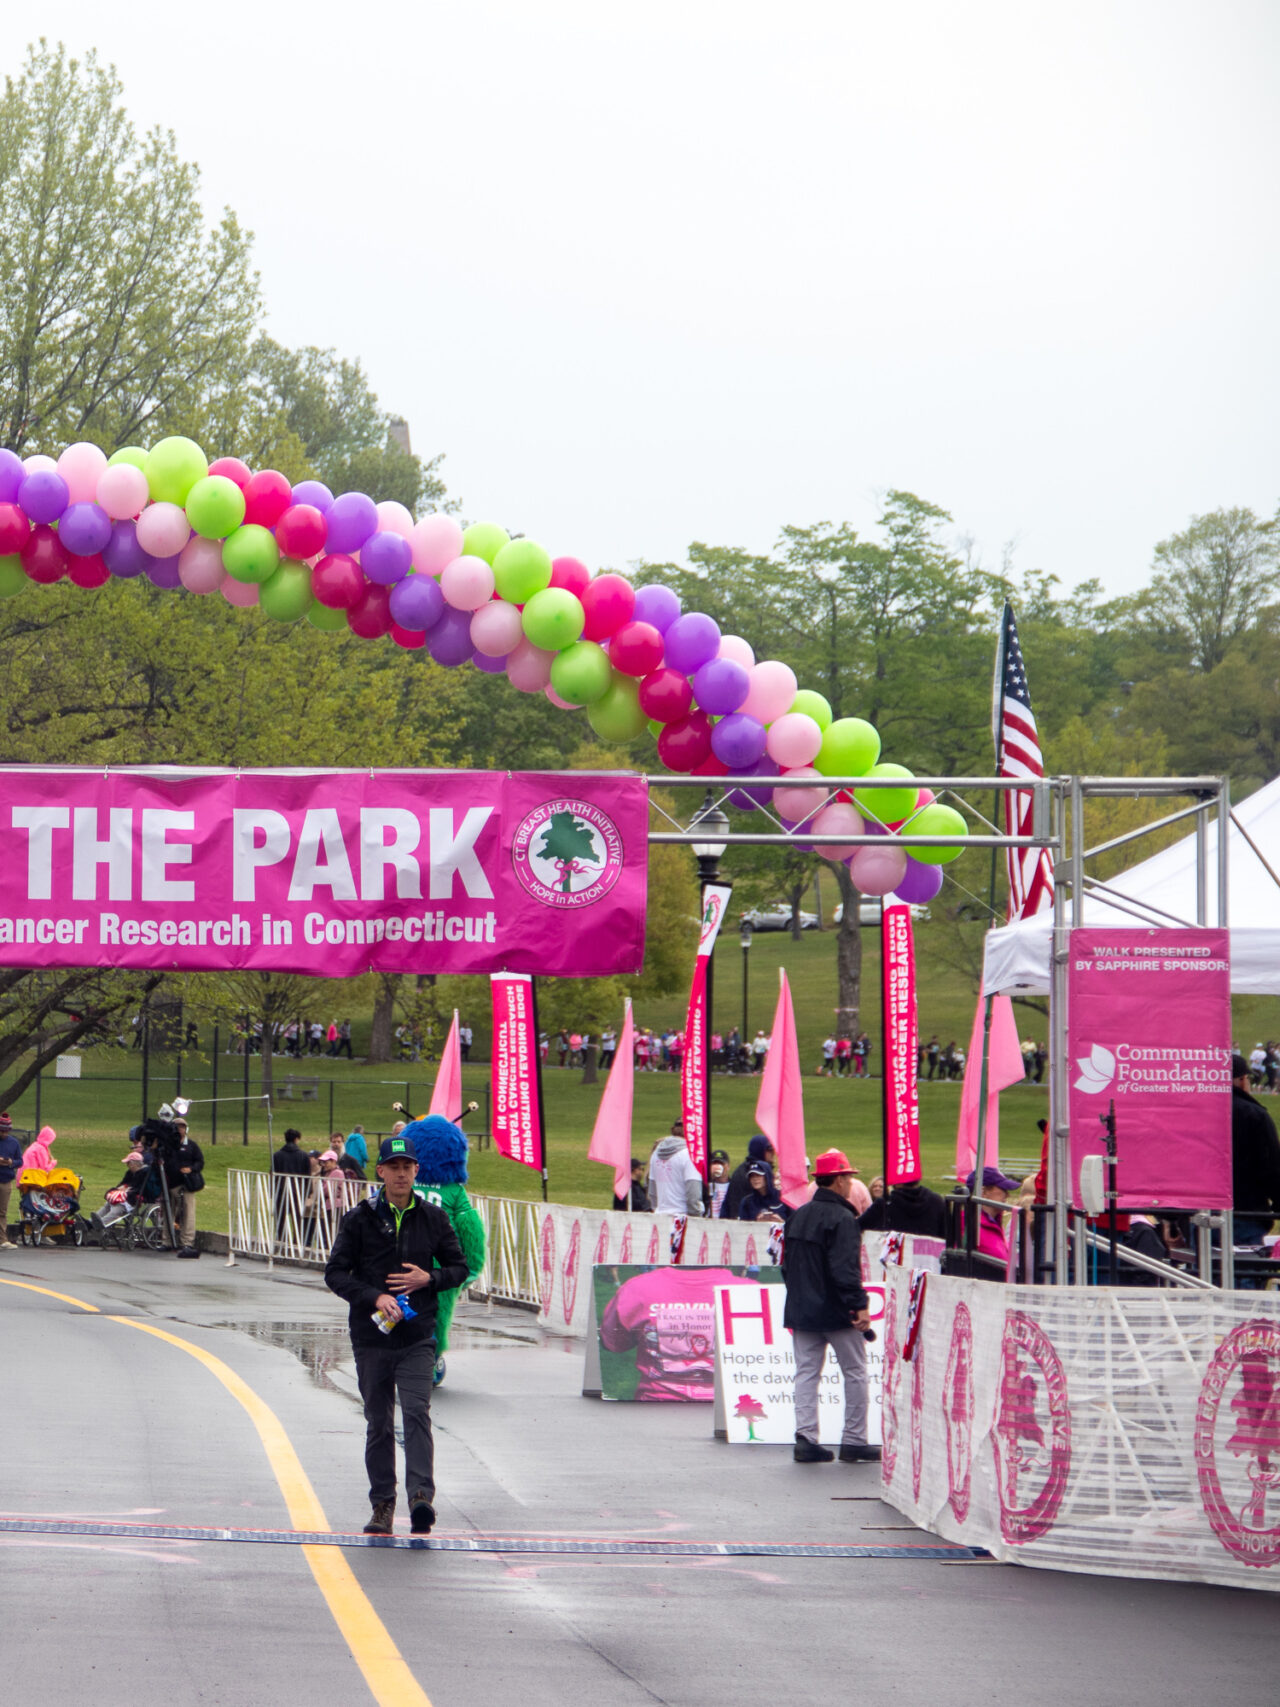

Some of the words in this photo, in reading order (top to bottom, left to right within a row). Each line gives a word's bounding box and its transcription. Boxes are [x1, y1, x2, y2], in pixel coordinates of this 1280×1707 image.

[547, 803, 591, 816] HEALTH
[517, 808, 547, 844] BREAST
[591, 811, 620, 865] INITIATIVE
[12, 805, 195, 901] THE
[232, 806, 496, 901] PARK
[515, 846, 525, 861] CT
[529, 881, 556, 902] HOPE
[556, 895, 566, 904] in
[567, 883, 604, 904] ACTION
[99, 911, 251, 946] Research
[262, 912, 293, 945] in
[303, 910, 497, 945] Connecticut
[1093, 946, 1130, 957] WALK
[1134, 946, 1211, 957] PRESENTED
[897, 914, 909, 1014] RESEARCH
[1075, 960, 1092, 971] BY
[1096, 960, 1160, 971] SAPPHIRE
[1163, 960, 1229, 971] SPONSOR:
[1116, 1043, 1232, 1067] Community
[1118, 1063, 1232, 1082] Foundation
[1117, 1082, 1130, 1094] of
[1130, 1083, 1169, 1093] Greater
[1172, 1083, 1195, 1093] New
[1197, 1083, 1232, 1093] Britain
[1237, 1330, 1280, 1354] HEALT
[722, 1352, 765, 1367] Hope
[769, 1352, 781, 1364] is
[733, 1371, 759, 1384] the
[763, 1371, 796, 1384] daw
[820, 1371, 840, 1384] nd
[767, 1391, 796, 1404] whi
[829, 1392, 840, 1404] is
